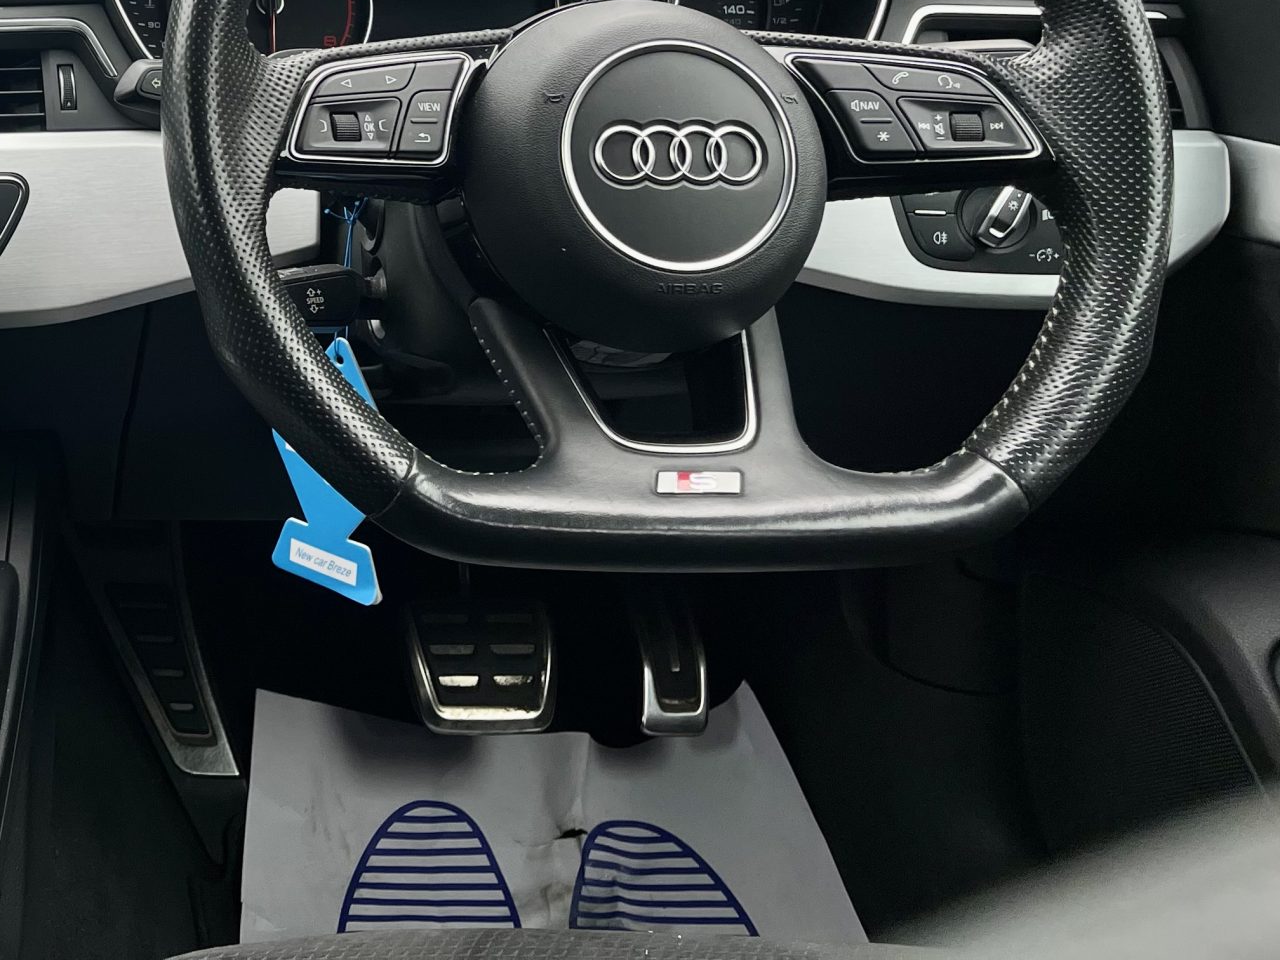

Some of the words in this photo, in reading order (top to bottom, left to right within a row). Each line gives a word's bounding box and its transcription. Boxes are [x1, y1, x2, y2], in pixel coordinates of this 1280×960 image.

[722, 4, 745, 15] 140
[147, 21, 161, 29] 90
[418, 102, 440, 112] VIEW
[860, 101, 880, 111] NAV
[363, 122, 375, 132] OK
[655, 282, 723, 295] AIRBAG
[306, 296, 325, 305] SPEED
[295, 547, 313, 561] New
[313, 557, 328, 567] car
[327, 560, 352, 577] Breze
